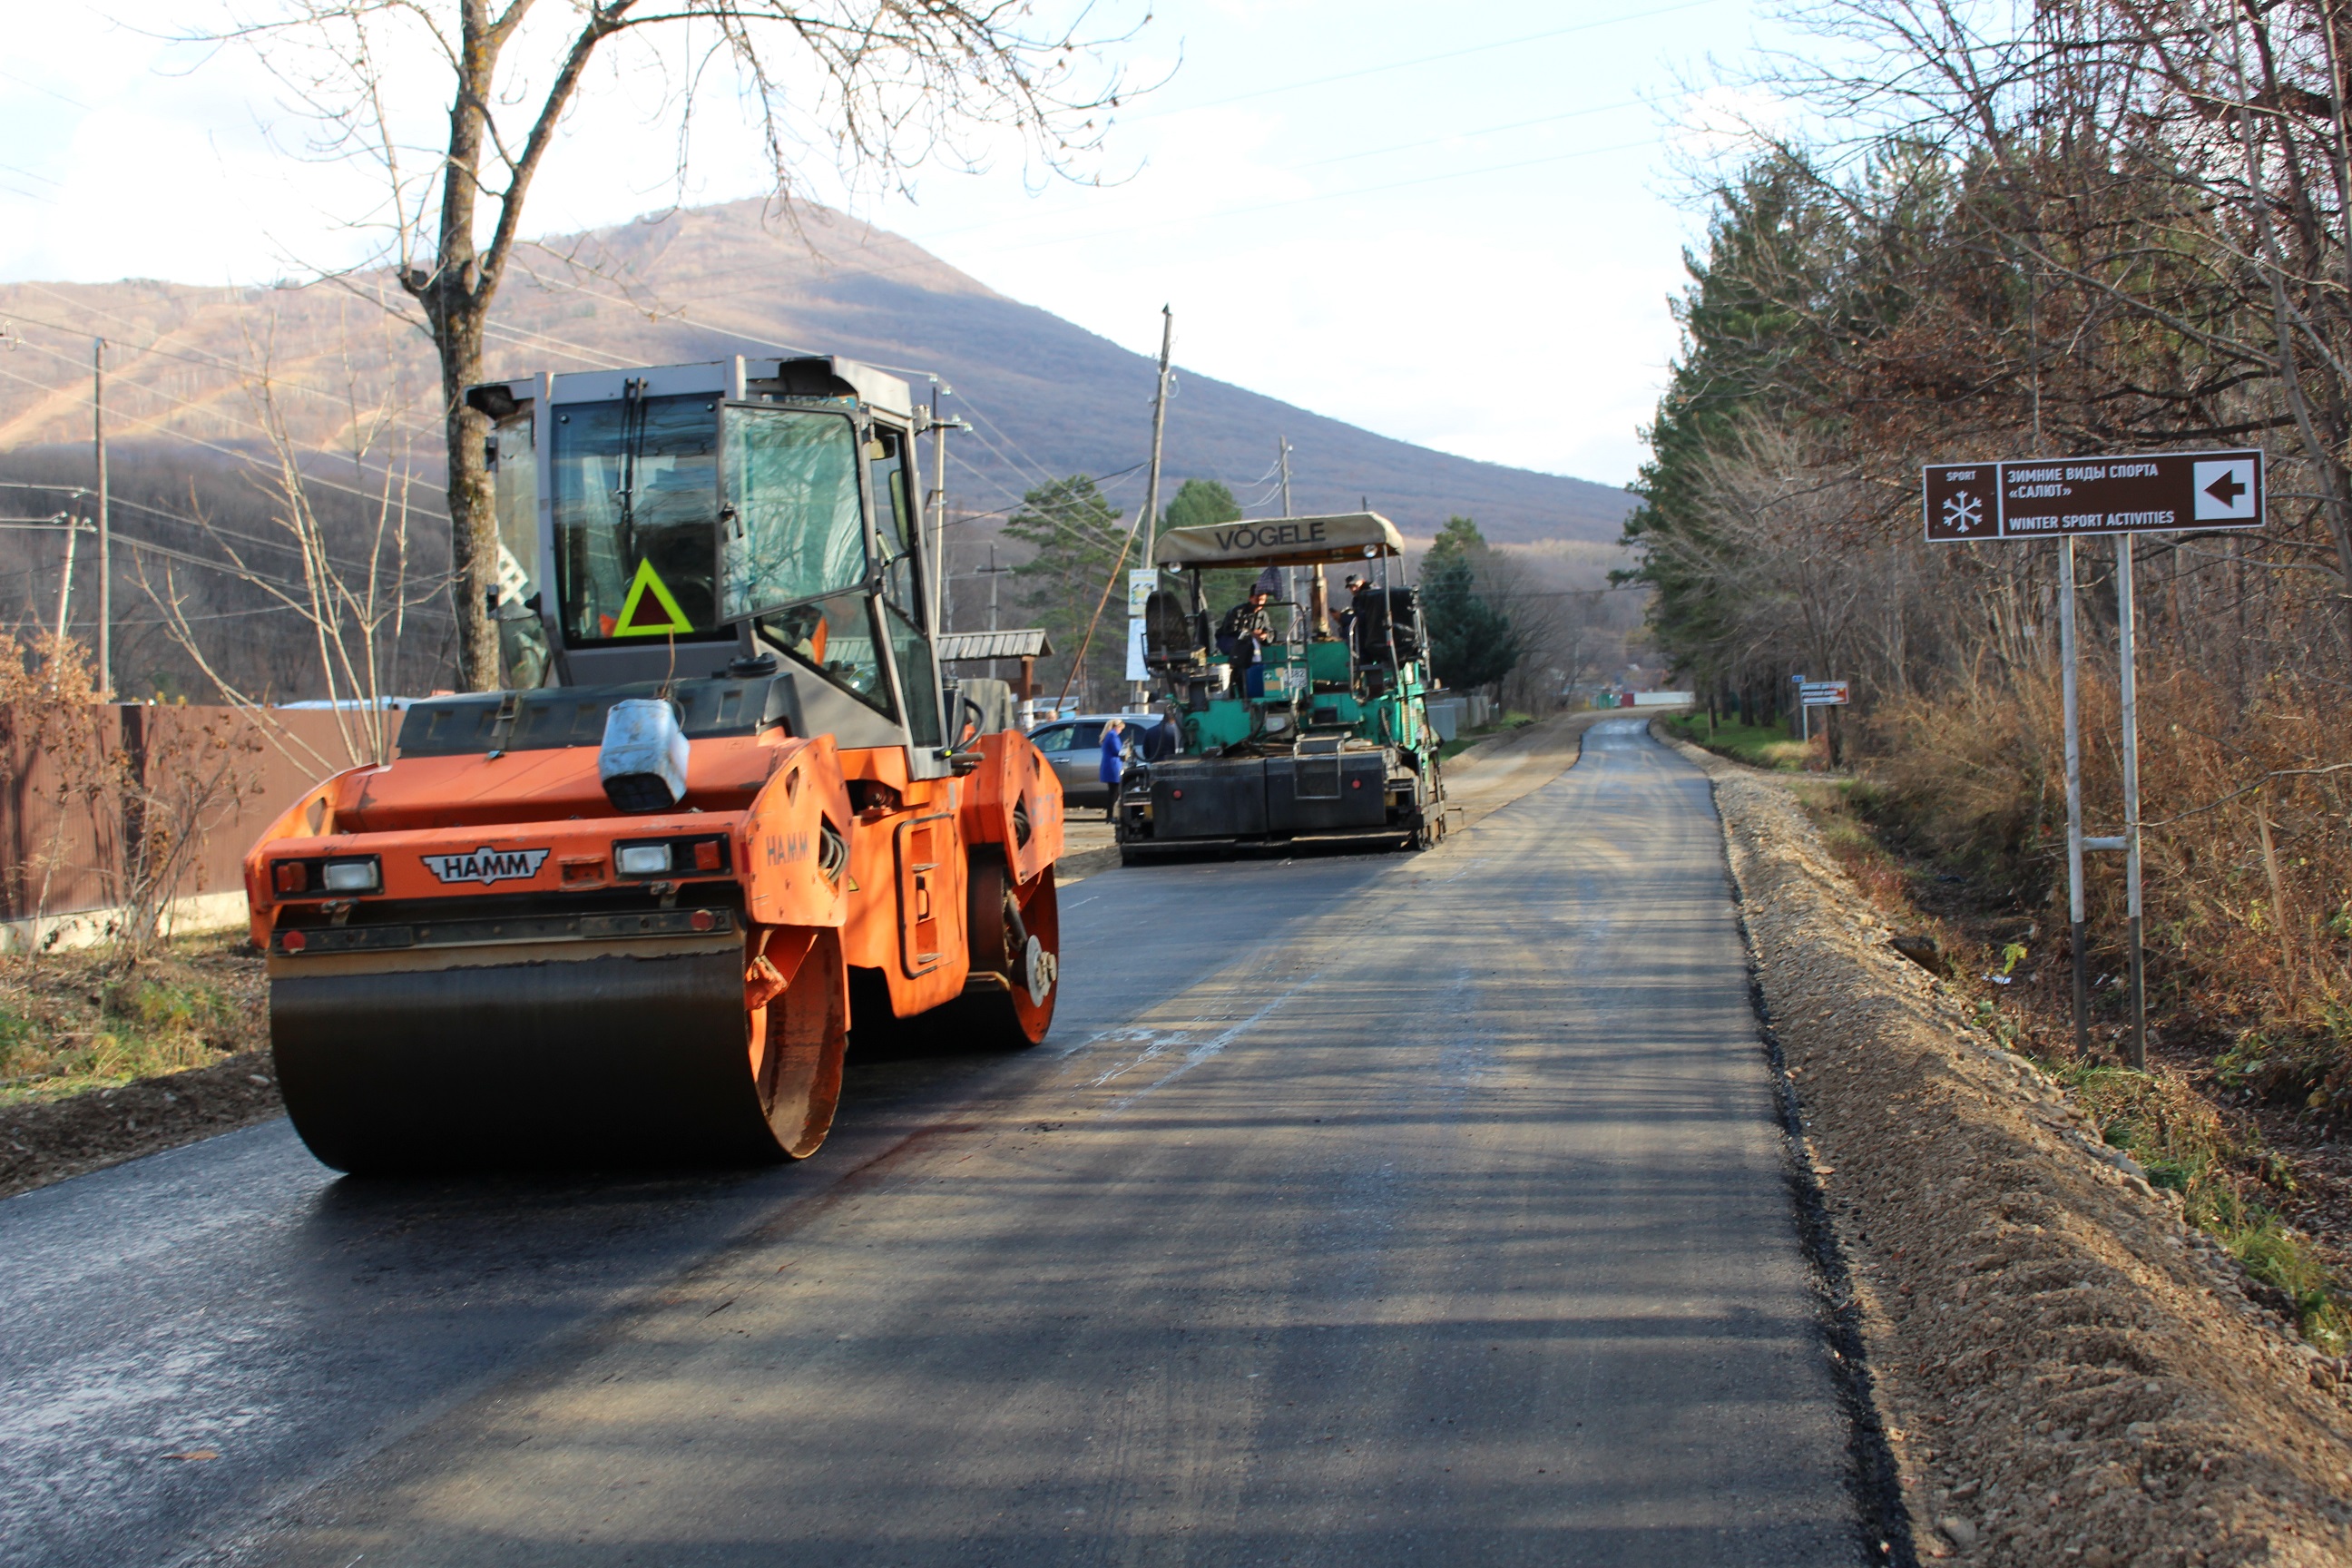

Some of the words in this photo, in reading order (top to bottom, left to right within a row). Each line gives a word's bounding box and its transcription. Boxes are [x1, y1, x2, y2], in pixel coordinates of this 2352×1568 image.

[1945, 470, 1976, 482] SPORT
[2007, 467, 2063, 484] ЗИМНИЕ
[2065, 466, 2105, 482] ВИДЫ
[2109, 464, 2159, 479] СПОРТА
[2008, 484, 2072, 499] «САЛЮТ»
[2009, 515, 2059, 531] WINTER
[2062, 513, 2103, 528] SPORT
[2106, 511, 2175, 527] ACTIVITIES
[1216, 521, 1327, 552] VÖGELE
[765, 830, 810, 867] HAMM
[444, 853, 530, 879] HAMM
